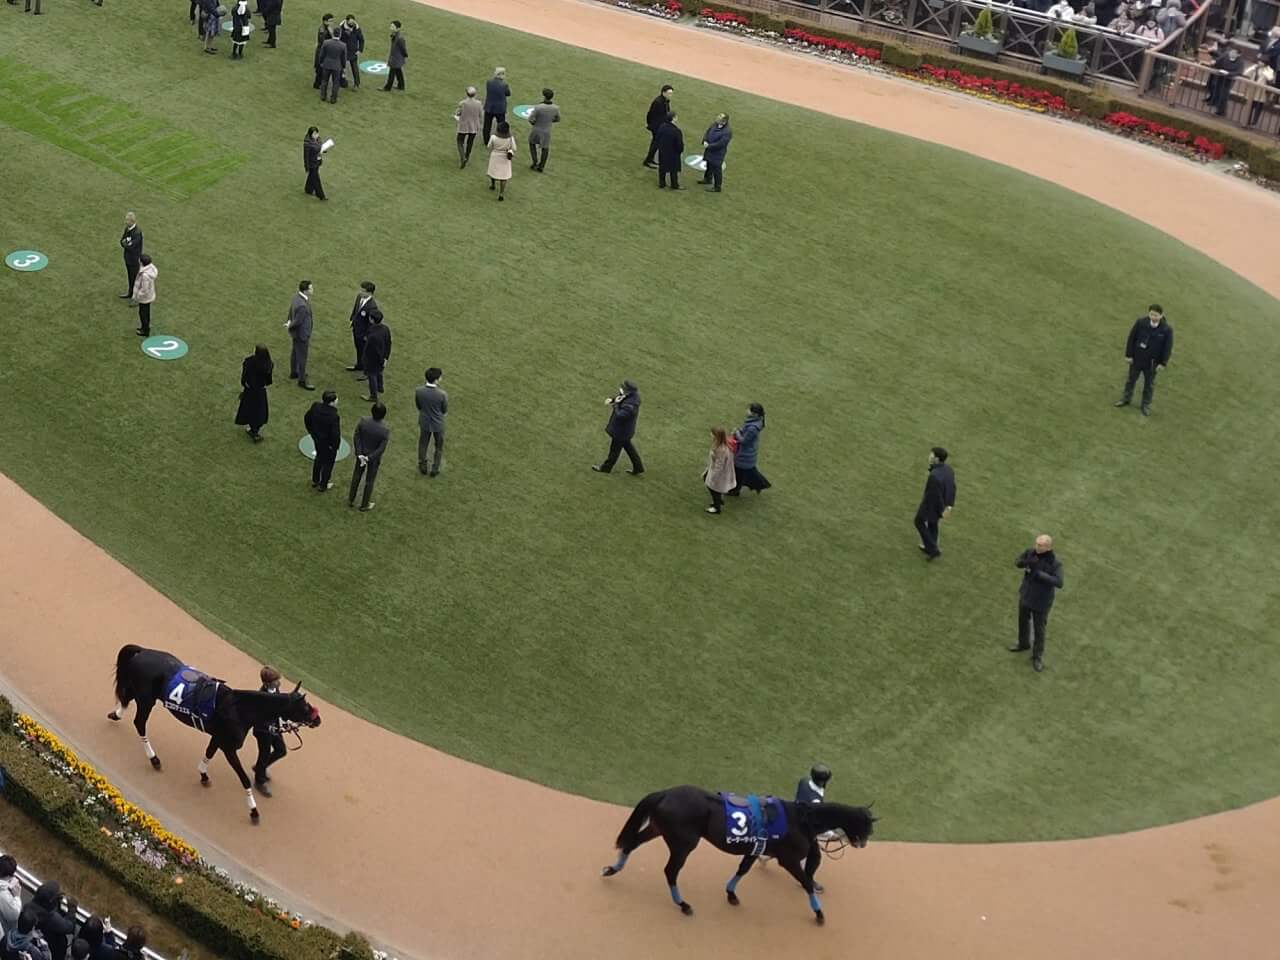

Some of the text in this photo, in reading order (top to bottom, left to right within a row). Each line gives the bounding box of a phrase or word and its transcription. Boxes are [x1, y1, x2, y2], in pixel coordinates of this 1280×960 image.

[13, 255, 40, 267] 3
[147, 340, 178, 356] 2
[169, 683, 185, 704] 4
[731, 811, 748, 836] 3
